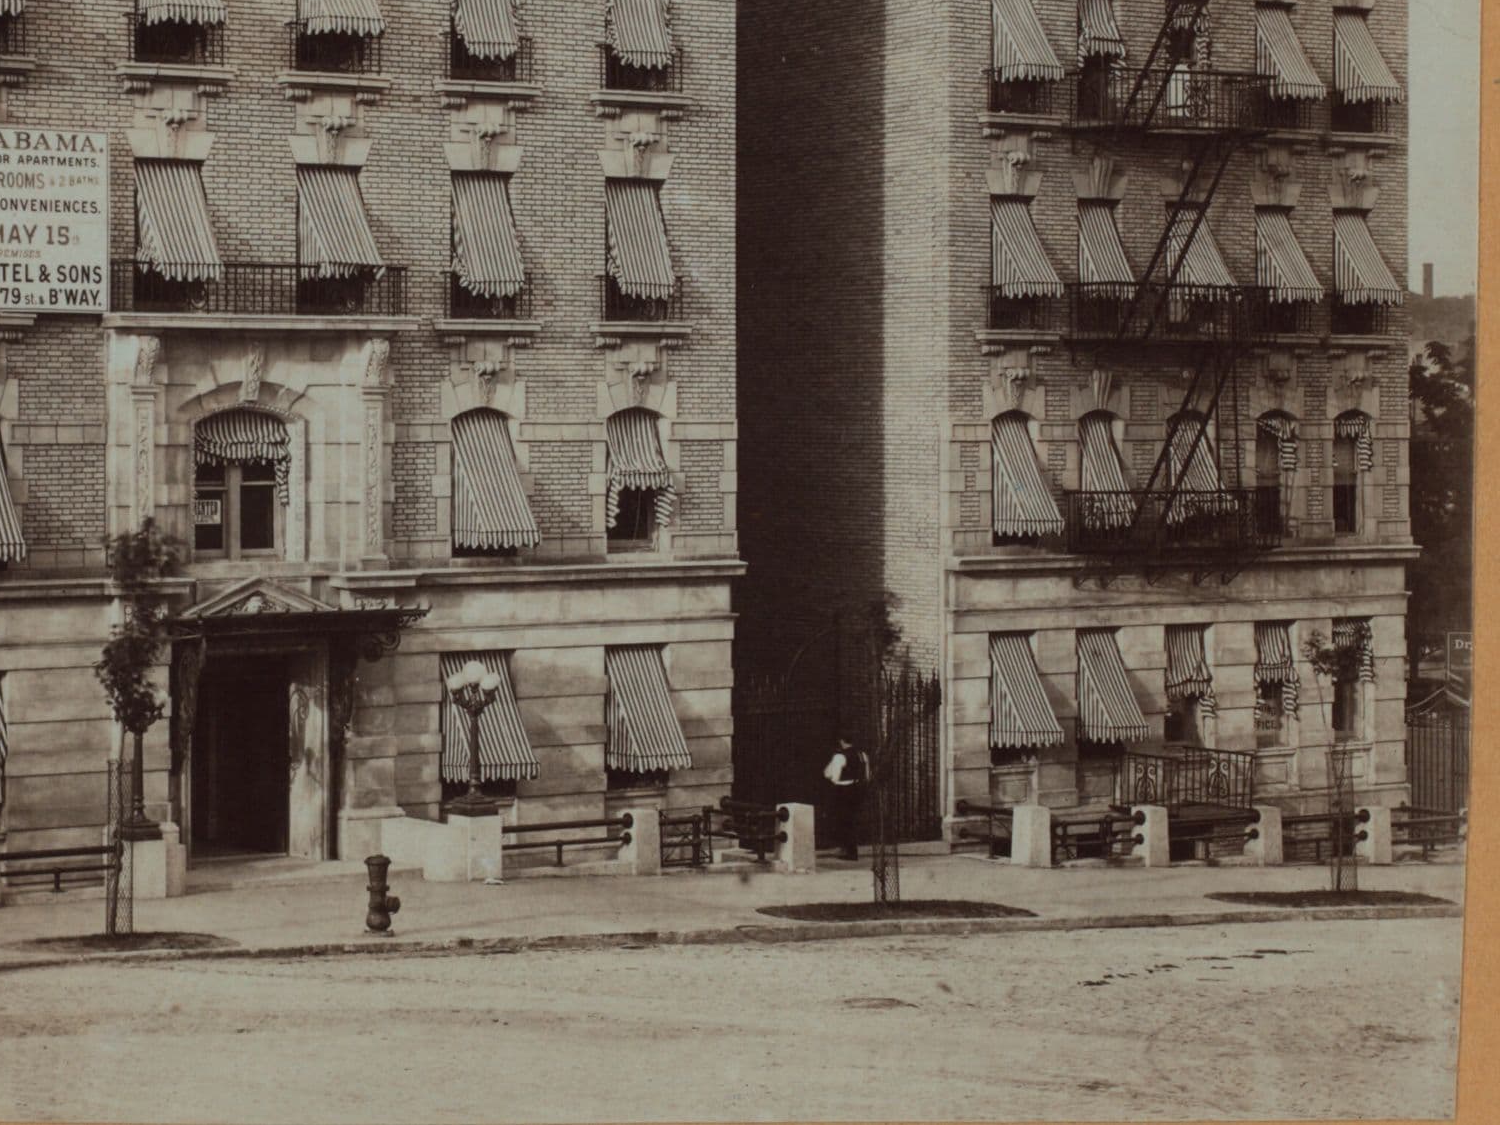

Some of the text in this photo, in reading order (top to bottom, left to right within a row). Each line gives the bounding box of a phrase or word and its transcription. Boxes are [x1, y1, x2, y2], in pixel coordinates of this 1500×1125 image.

[17, 154, 100, 168] APARTMENTS.
[39, 264, 51, 283] &
[57, 265, 102, 284] SONS
[48, 288, 102, 306] B'WAY.
